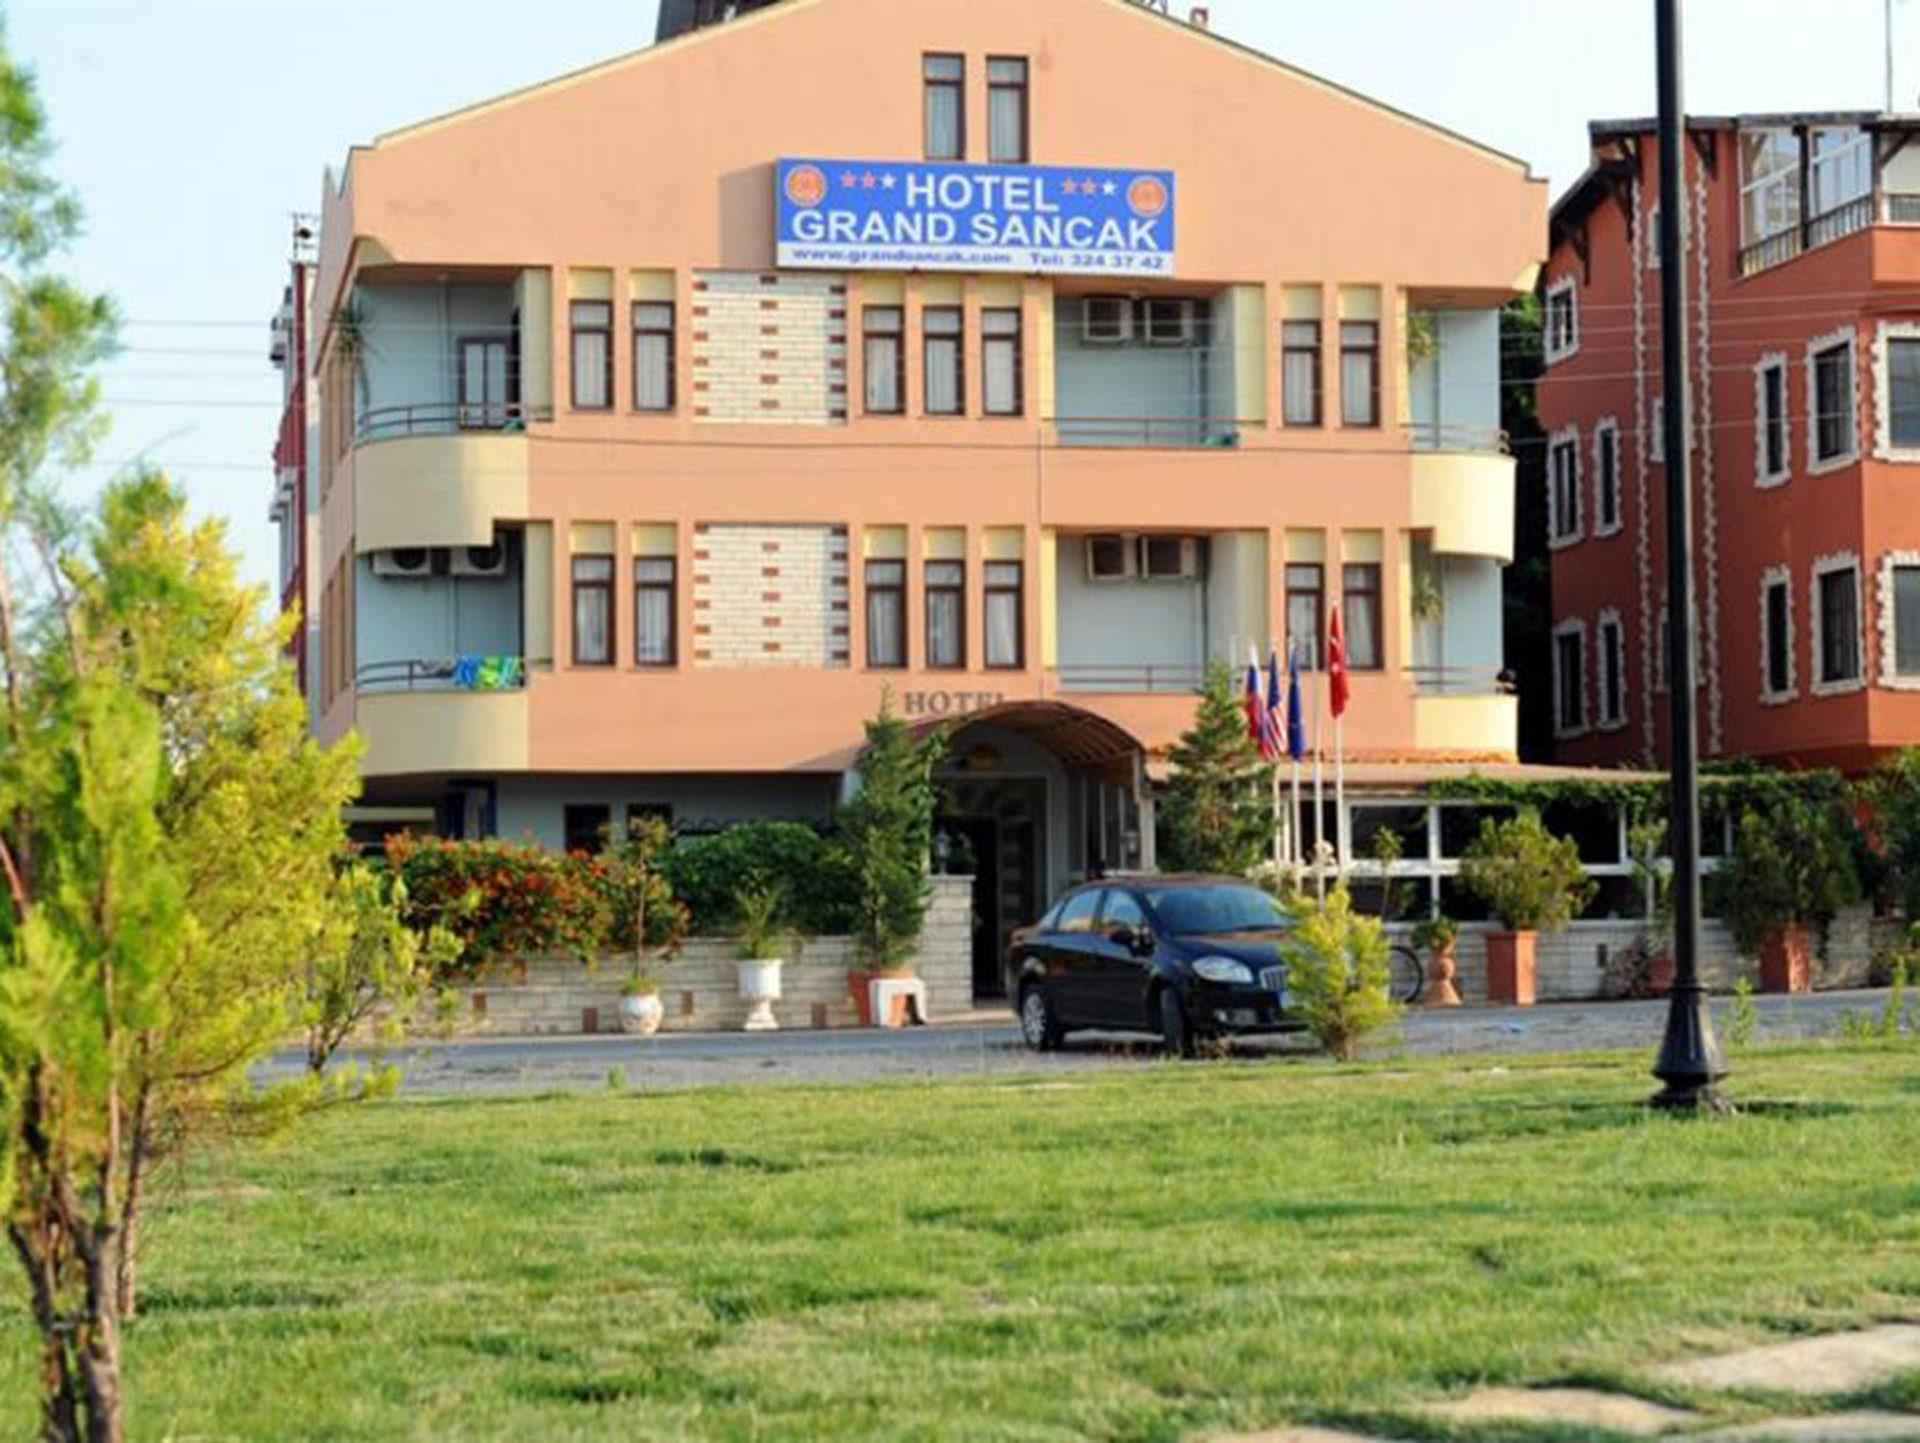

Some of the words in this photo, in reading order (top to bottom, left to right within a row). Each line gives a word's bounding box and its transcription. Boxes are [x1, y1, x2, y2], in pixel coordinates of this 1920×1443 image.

[907, 173, 1059, 211] HOTEL
[792, 209, 956, 243] GRAND
[971, 213, 1158, 250] SANCAK
[1071, 254, 1105, 267] 324
